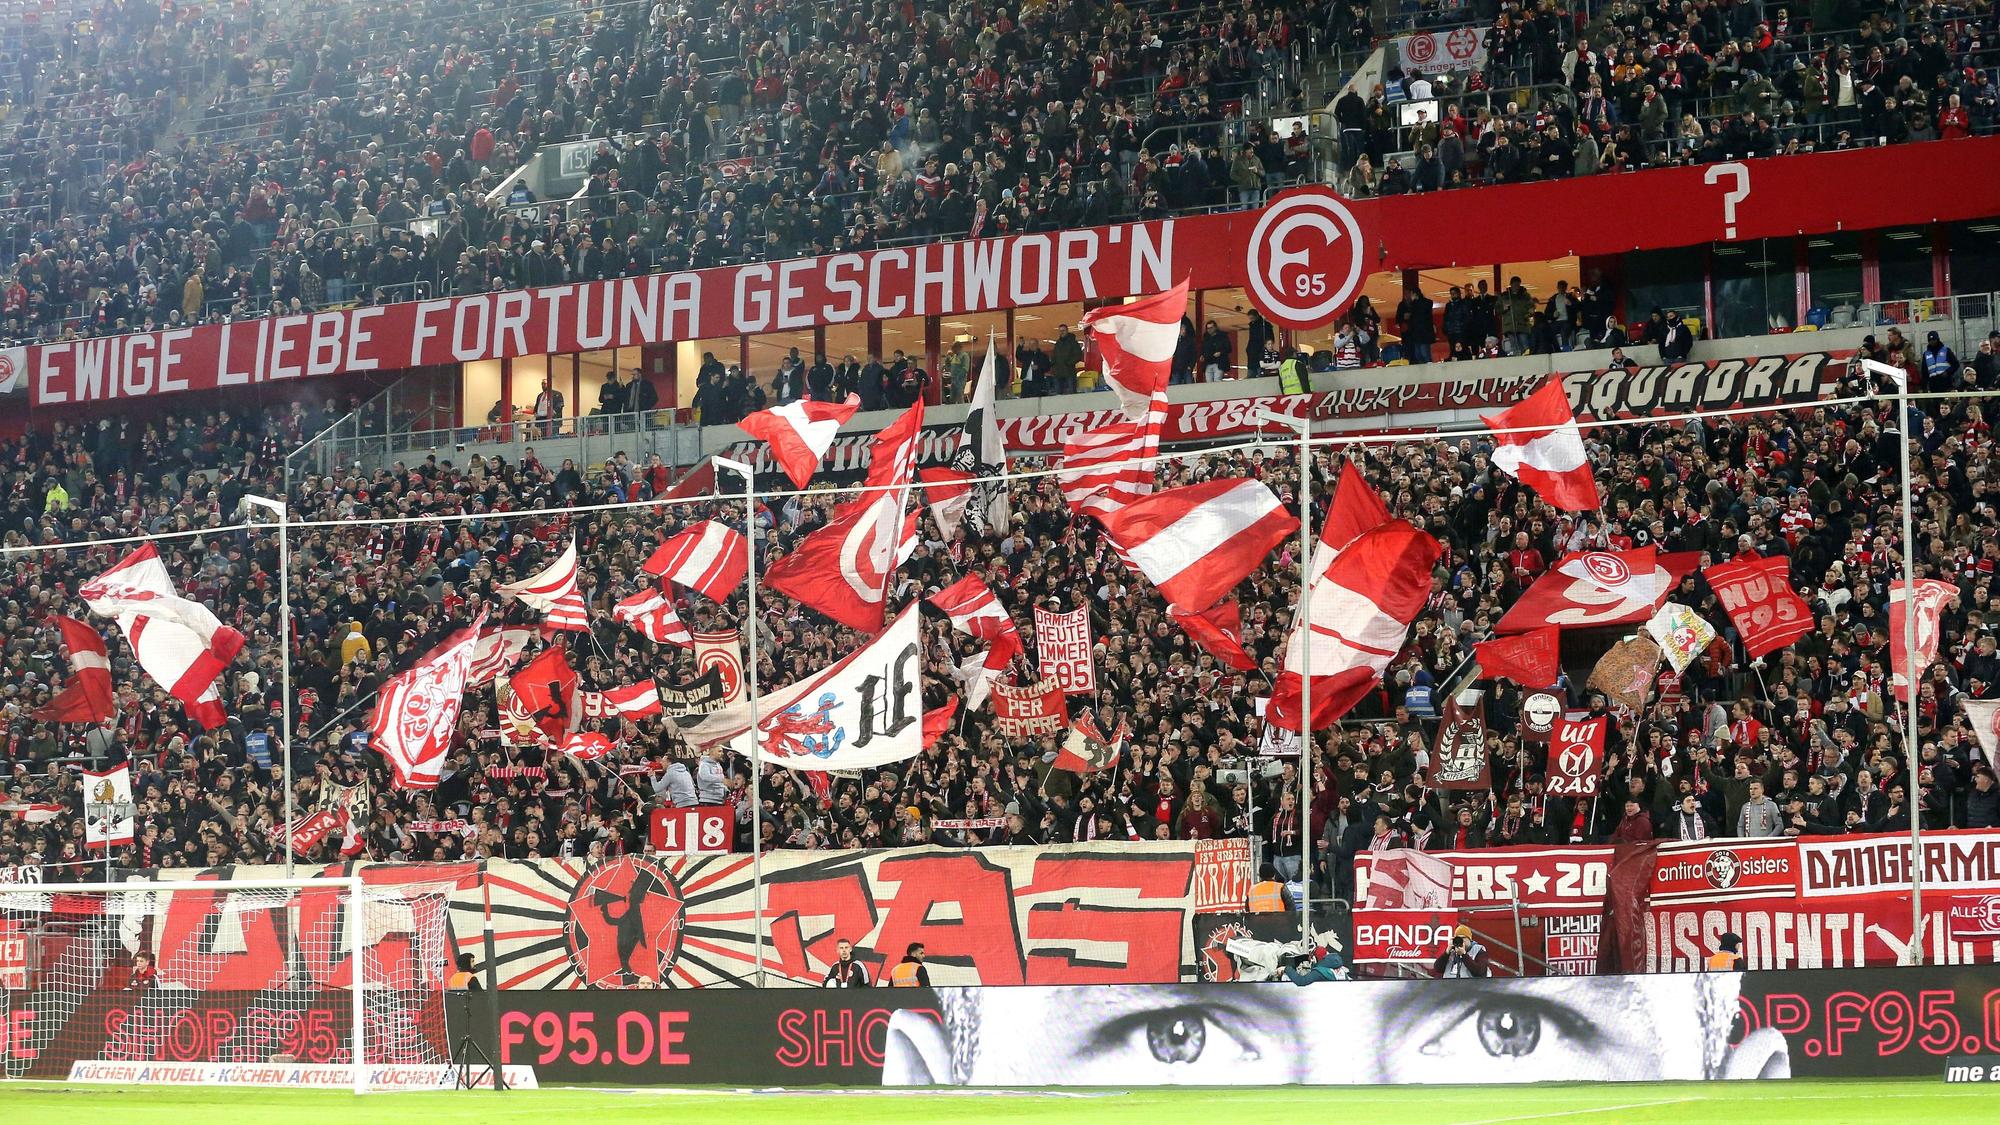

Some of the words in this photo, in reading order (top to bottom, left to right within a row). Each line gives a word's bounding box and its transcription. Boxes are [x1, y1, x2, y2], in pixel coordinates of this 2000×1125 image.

[1704, 162, 1751, 240] ?
[1295, 273, 1327, 297] 95
[38, 329, 193, 404] EWIGE
[217, 306, 385, 385] LIEBE
[411, 272, 702, 367] FORTUNA
[733, 219, 1175, 333] GESCHWOR'N
[1564, 353, 1823, 416] SQUADRA
[1035, 608, 1086, 624] DAMALS
[1734, 598, 1797, 638] F95
[1037, 623, 1087, 643] HEUTE
[1040, 642, 1088, 660] IMMER
[1007, 698, 1044, 717] PER
[998, 713, 1063, 737] SEMPRE
[1560, 722, 1599, 743] ULT
[1546, 774, 1597, 794] RAS
[1657, 863, 1703, 882] antira
[1742, 857, 1789, 875] sisters
[1196, 860, 1251, 905] KRAFT
[1951, 906, 1987, 918] ALLES
[1356, 924, 1453, 946] BANDA
[500, 1010, 691, 1067] F95.DE
[1948, 1066, 1984, 1082] me
